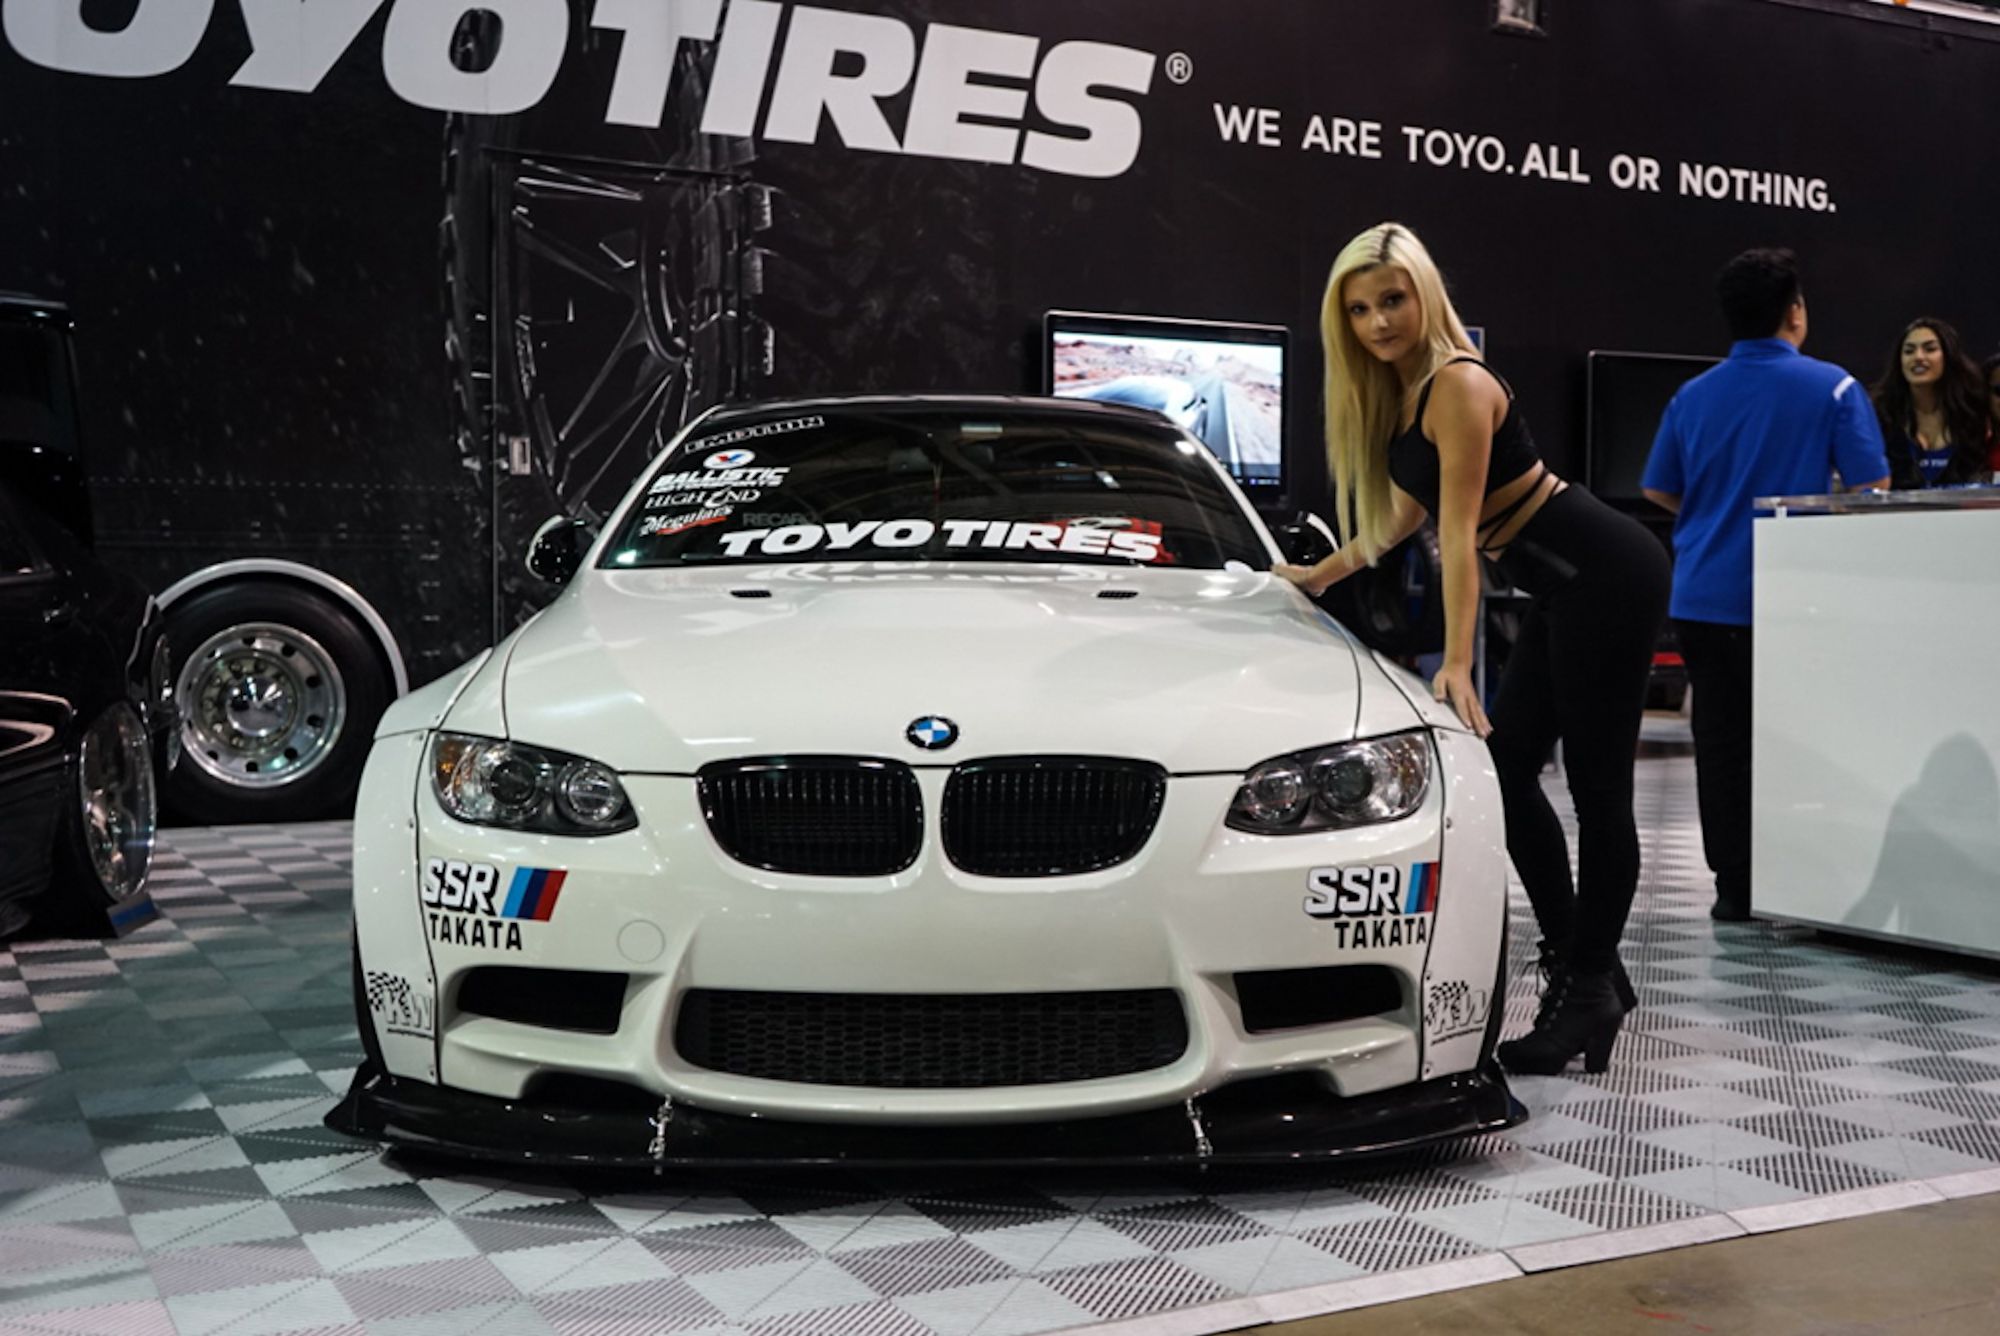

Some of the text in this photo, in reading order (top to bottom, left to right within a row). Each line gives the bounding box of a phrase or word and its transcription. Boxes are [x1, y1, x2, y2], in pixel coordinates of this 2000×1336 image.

[1213, 102, 1281, 147] WE
[1301, 114, 1382, 159] ARE
[1521, 142, 1591, 184] ALL
[1608, 154, 1661, 192] OR
[1679, 162, 1837, 213] NOTHING.
[649, 467, 790, 490] BALLISTIC
[645, 490, 706, 510] HIGH
[719, 518, 1164, 562] TOYO TIRES
[421, 856, 500, 917] SSR
[1303, 864, 1402, 919] SSR
[429, 913, 523, 951] TAKATA
[1334, 916, 1427, 949] TAKATA
